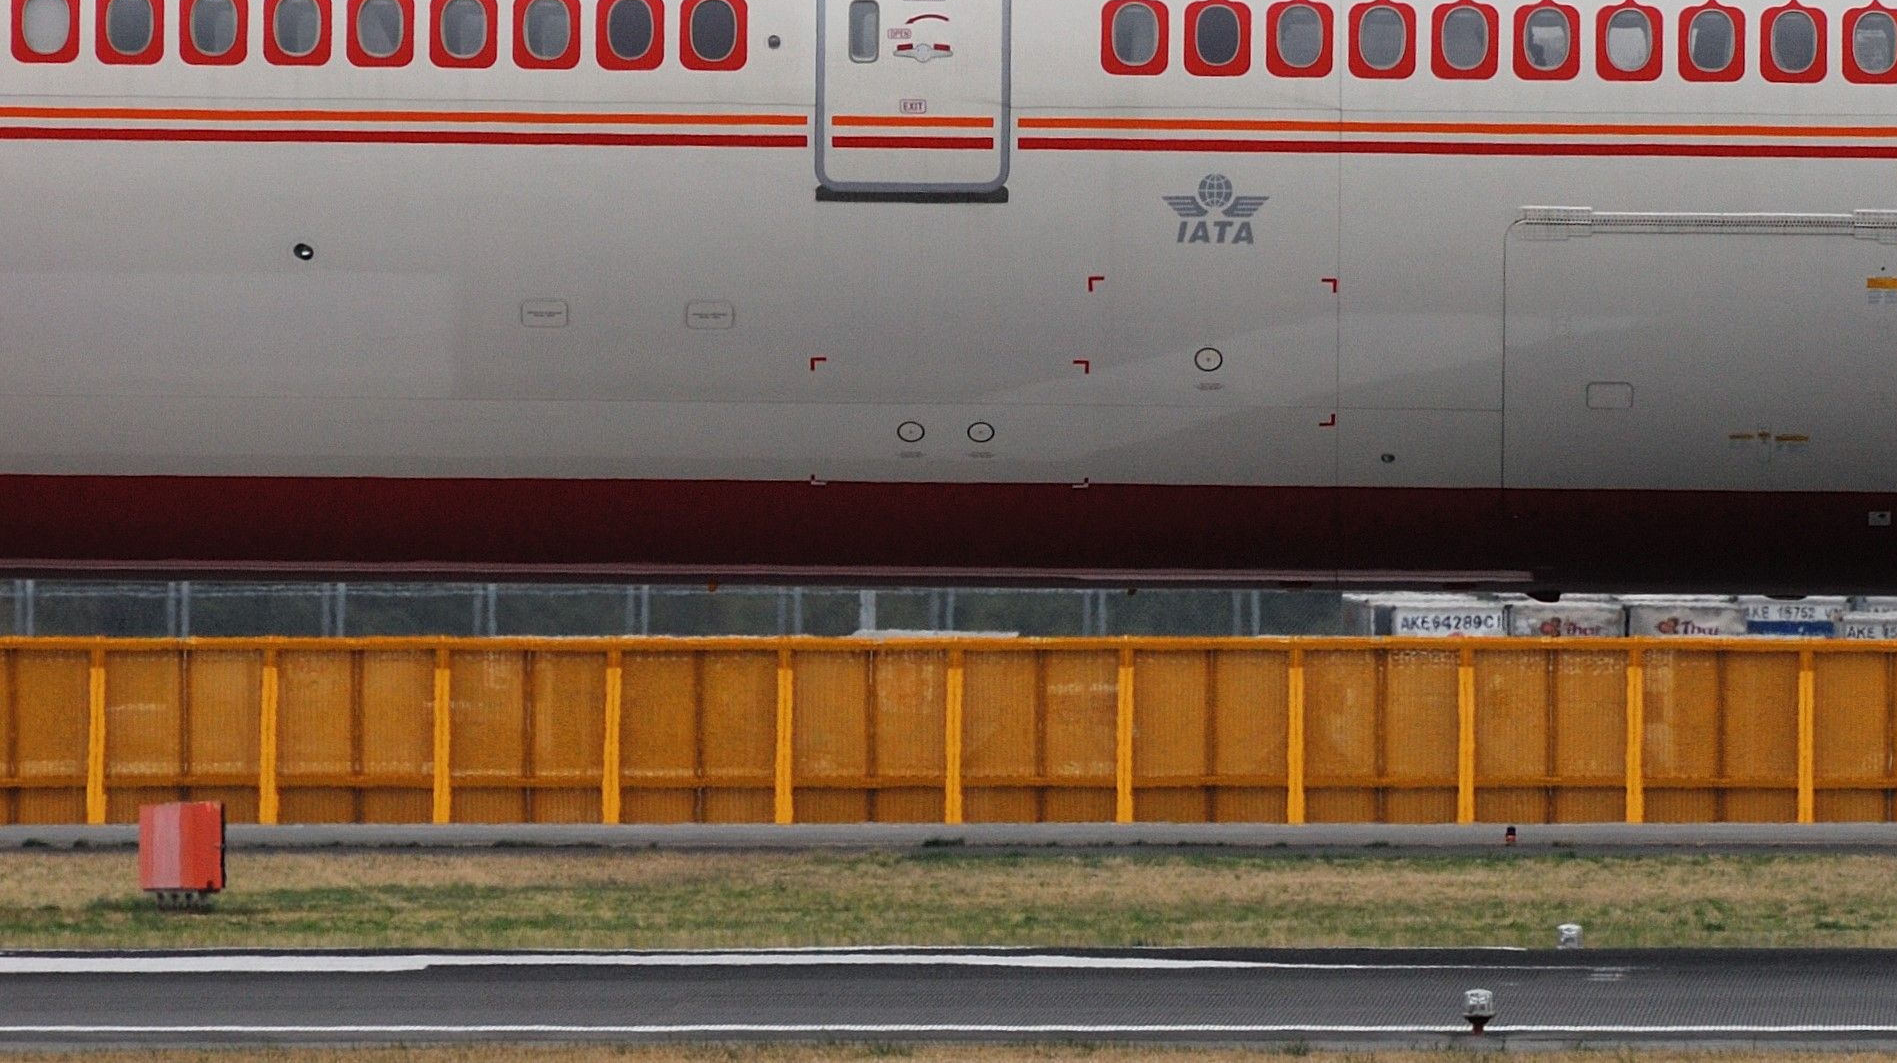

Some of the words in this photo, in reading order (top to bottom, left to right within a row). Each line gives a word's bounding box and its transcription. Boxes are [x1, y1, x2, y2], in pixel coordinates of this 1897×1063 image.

[890, 29, 911, 38] OPEN
[903, 101, 924, 112] EXIT
[1176, 220, 1255, 245] IATA
